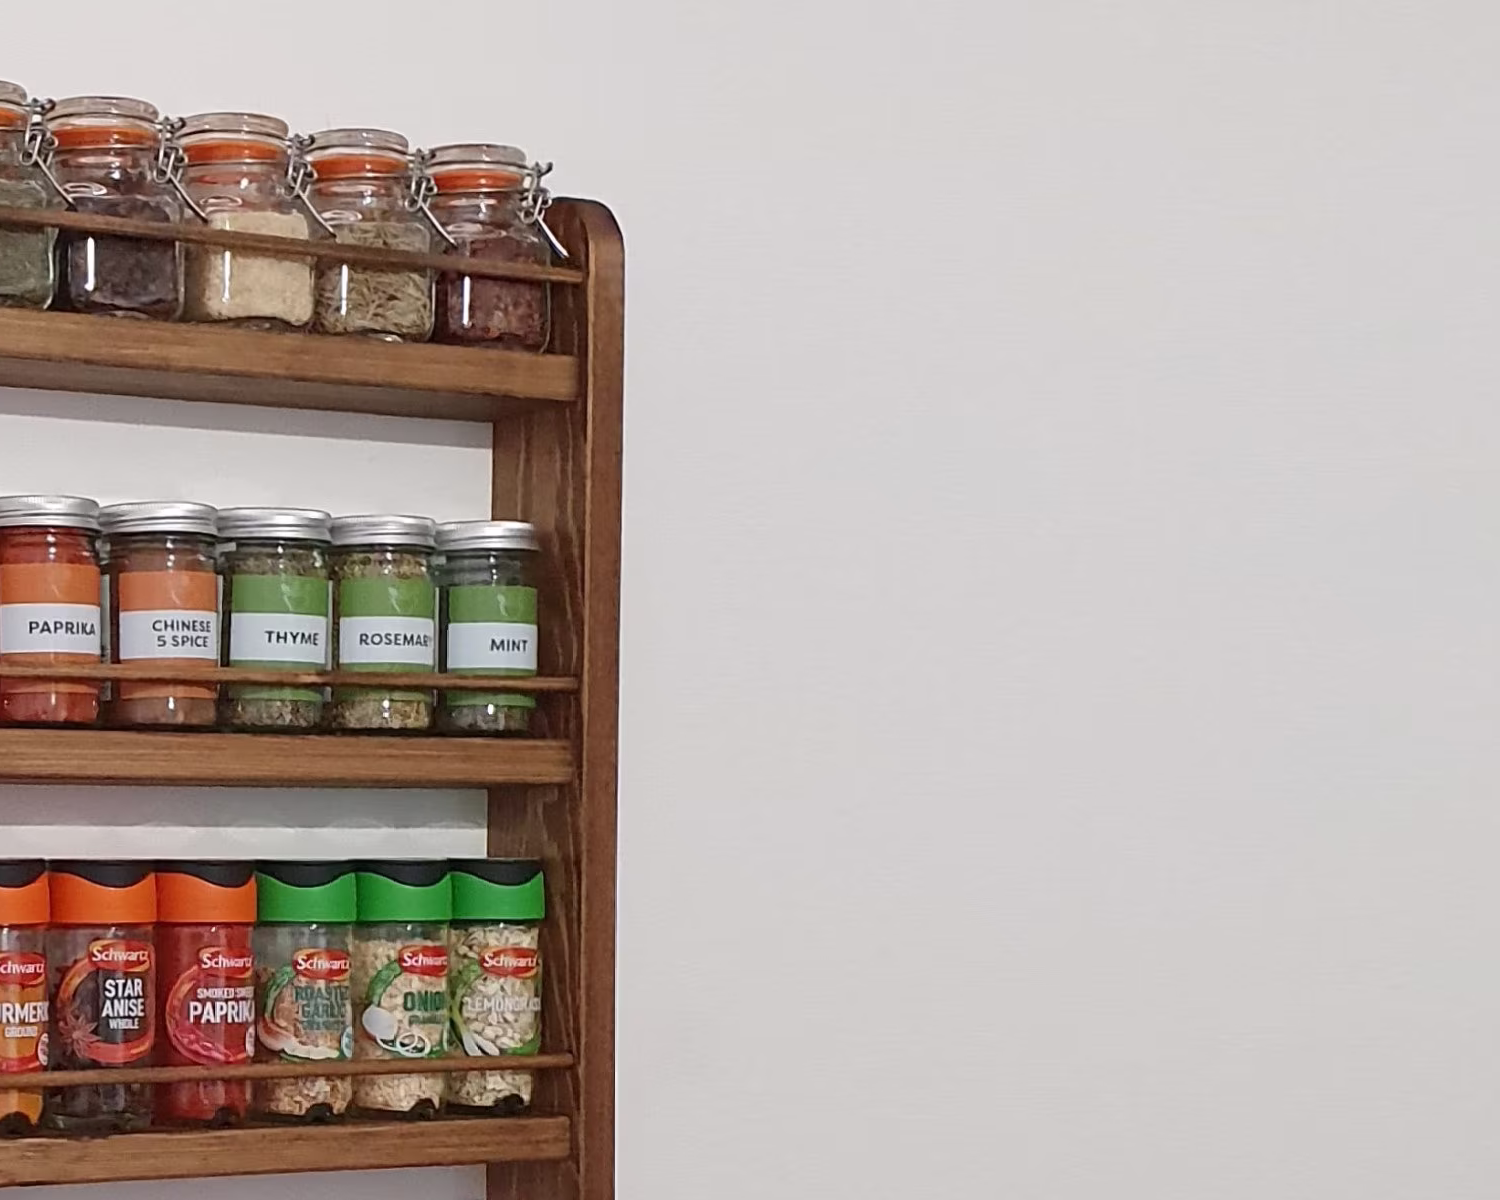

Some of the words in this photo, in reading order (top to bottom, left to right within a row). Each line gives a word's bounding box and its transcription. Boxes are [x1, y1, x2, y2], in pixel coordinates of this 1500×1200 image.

[28, 621, 96, 636] PAPRIKA
[152, 620, 212, 633] CHINESE
[157, 635, 167, 648] 5
[171, 635, 209, 648] SPICE
[264, 630, 320, 647] THYME
[489, 638, 528, 653] MINT
[92, 946, 149, 961] Schwartz
[104, 978, 143, 998] STAR
[101, 998, 145, 1017] ANISE
[109, 1018, 140, 1029] WHOLE
